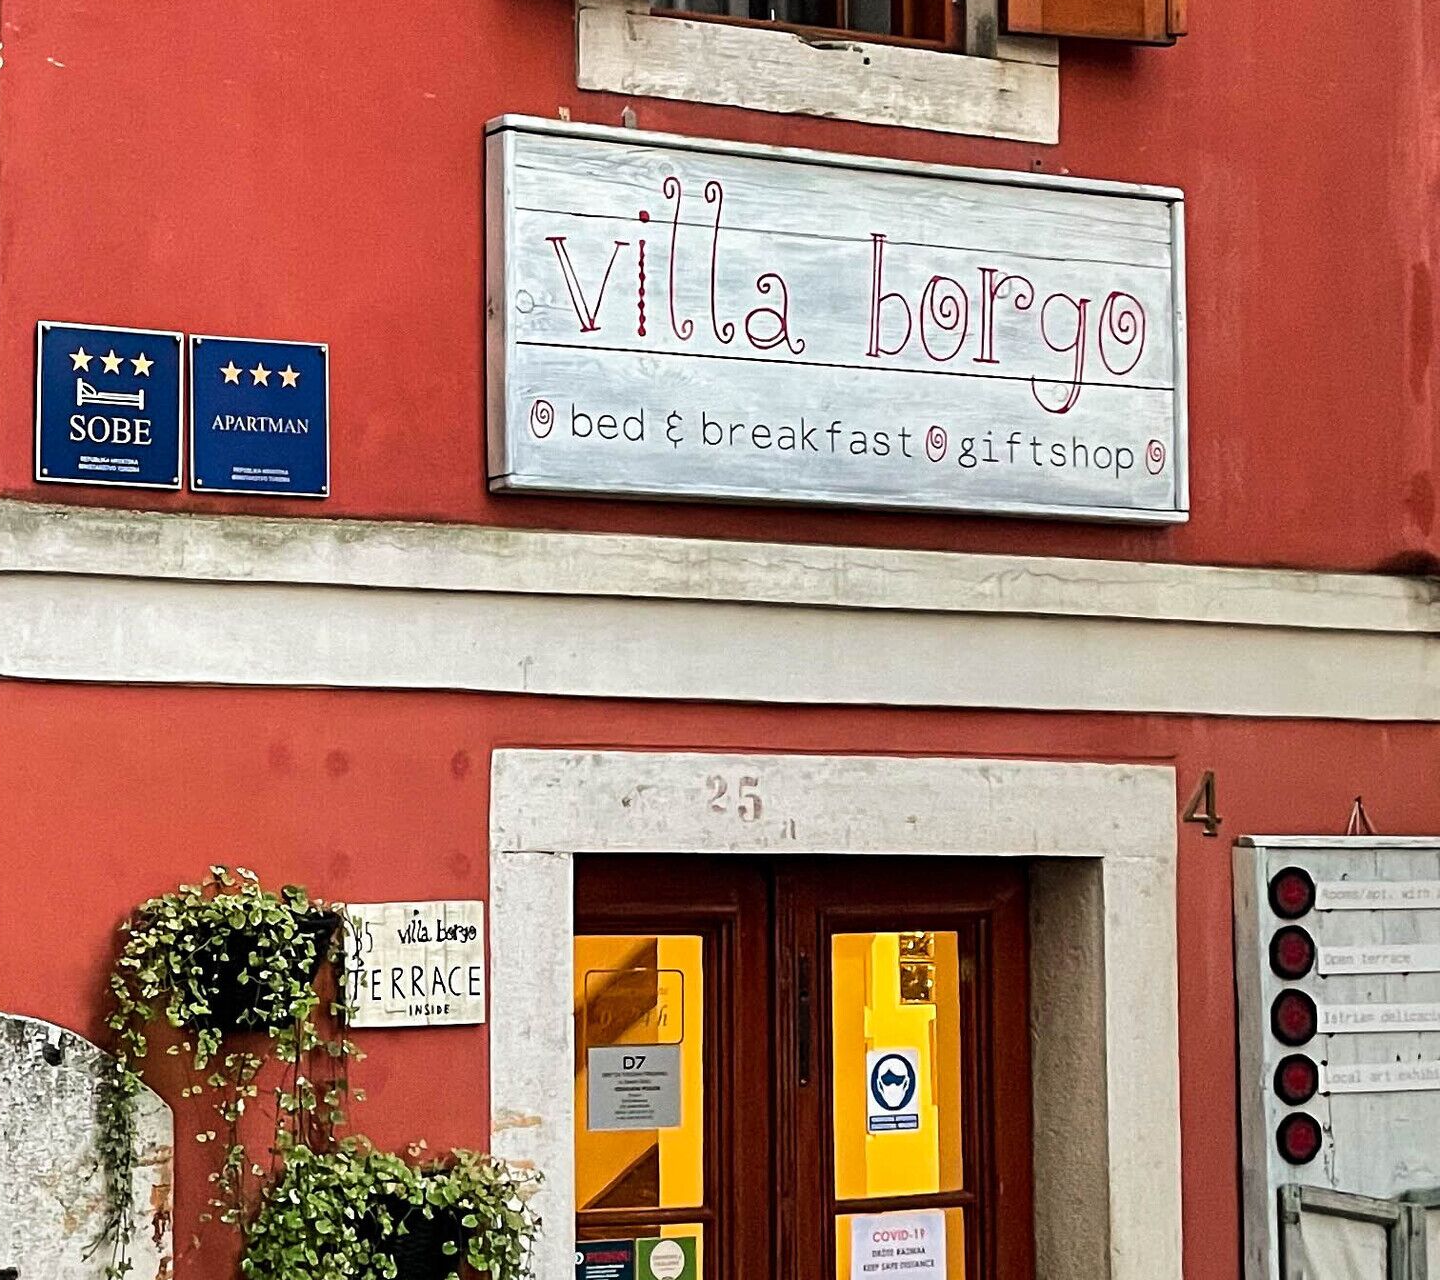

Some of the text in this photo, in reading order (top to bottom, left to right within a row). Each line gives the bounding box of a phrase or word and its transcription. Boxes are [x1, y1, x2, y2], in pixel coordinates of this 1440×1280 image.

[545, 177, 1146, 414] villa borgo
[69, 414, 152, 446] SOBE
[211, 414, 309, 434] APARTMAN
[571, 403, 1135, 479] bed & breakfast giftshop
[705, 775, 763, 823] 25
[1183, 771, 1223, 837] 4
[397, 909, 433, 944] villa
[436, 919, 477, 944] borgo
[1361, 952, 1411, 965] terrace
[348, 966, 481, 1001] TERRACE
[409, 1004, 450, 1016] INSIDE
[623, 1056, 646, 1070] D7
